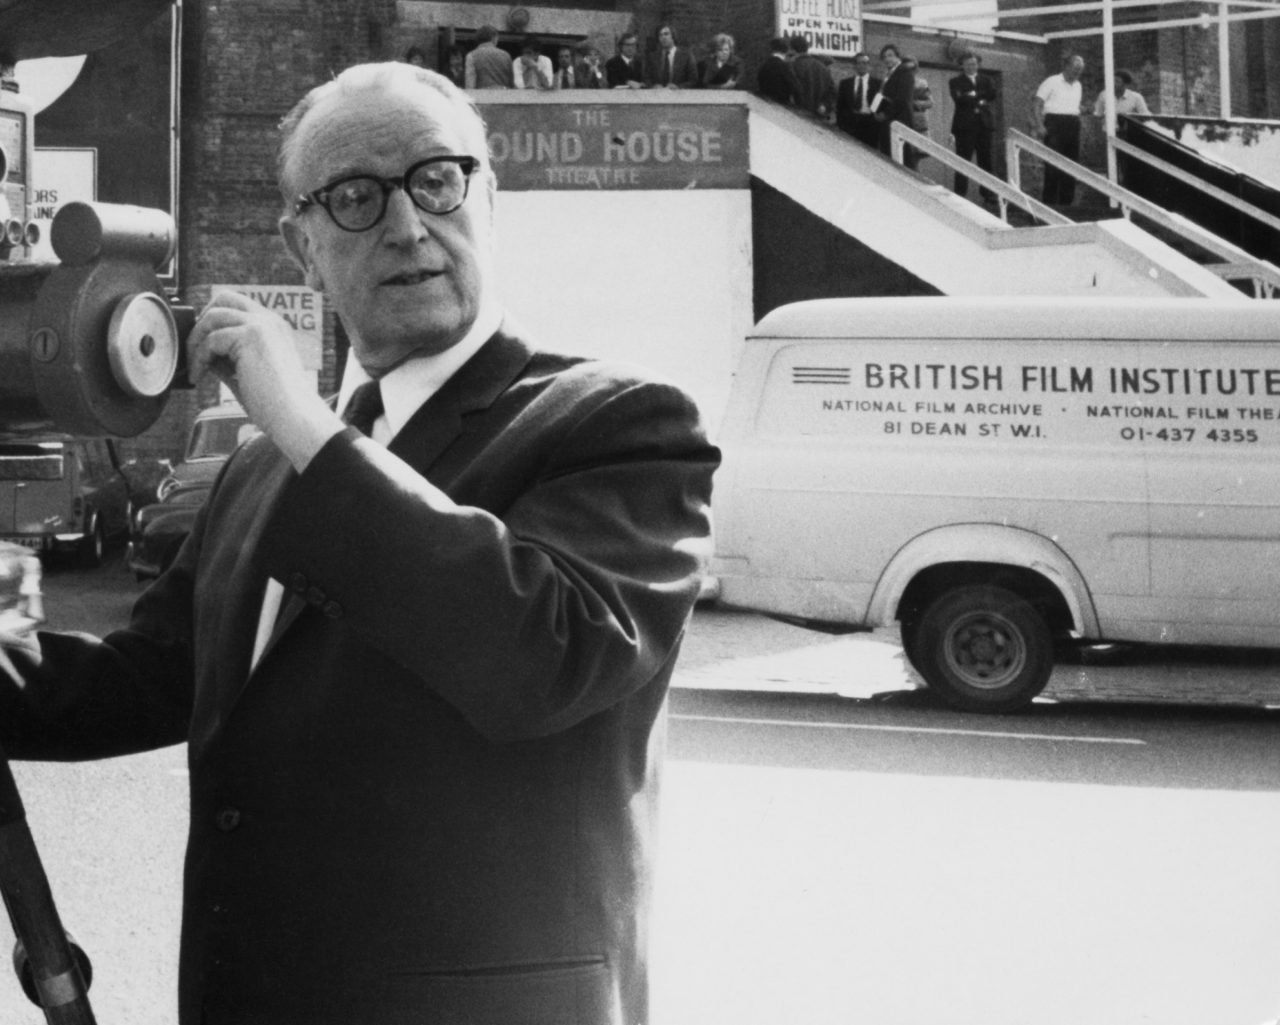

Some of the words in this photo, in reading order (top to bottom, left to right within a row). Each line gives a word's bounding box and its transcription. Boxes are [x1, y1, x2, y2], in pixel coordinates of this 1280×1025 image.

[788, 18, 821, 28] OPEN
[826, 21, 853, 32] TILL
[573, 110, 610, 126] THE
[488, 130, 583, 163] OUND
[603, 130, 722, 163] HOUSE
[864, 363, 1003, 391] BRITISH
[1022, 366, 1093, 394] FILM
[1110, 367, 1280, 396] INSTITUTE
[822, 400, 907, 413] NATIONAL
[915, 402, 956, 414] FILM
[964, 403, 1042, 416] ARCHIVE
[1086, 405, 1179, 419] NATIONAL
[1186, 407, 1230, 420] FILM
[1236, 408, 1280, 420] THE
[911, 422, 967, 436] DEAN
[1120, 427, 1196, 442] 01-437
[1206, 428, 1258, 443] 4355
